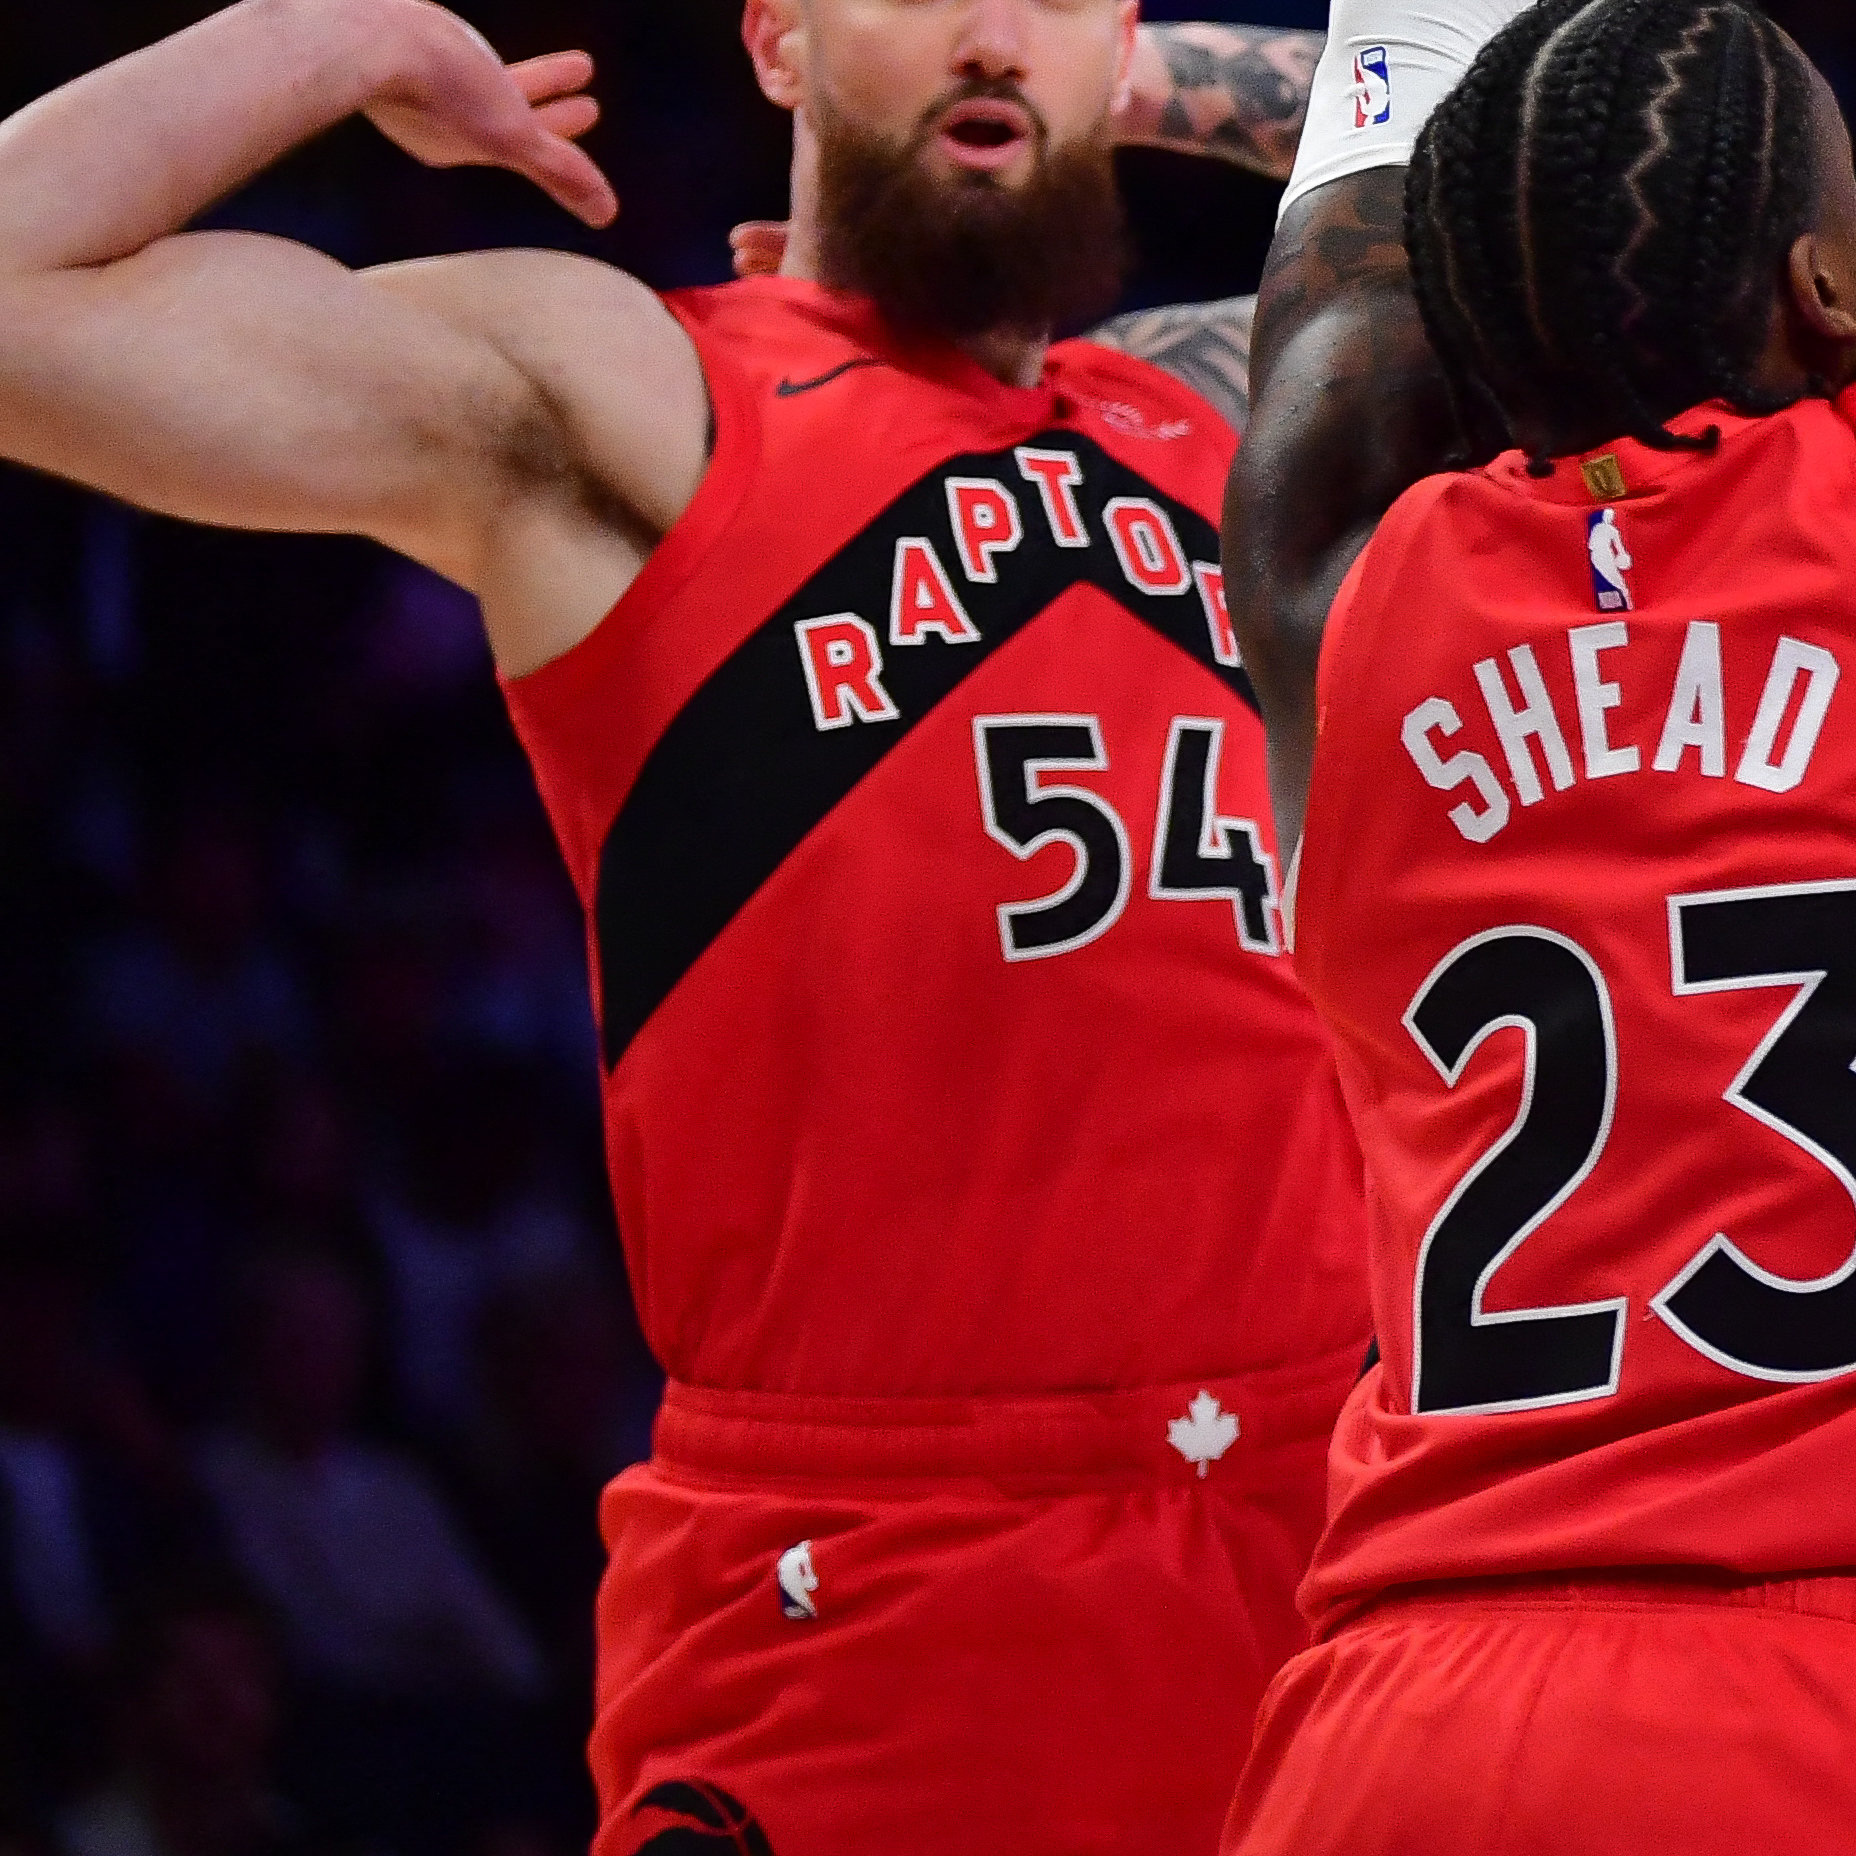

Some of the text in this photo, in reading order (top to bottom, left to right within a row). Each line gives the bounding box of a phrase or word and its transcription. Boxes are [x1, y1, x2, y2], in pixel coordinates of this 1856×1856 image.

[795, 447, 1242, 731] RAPTO
[972, 714, 1280, 963] 54
[1401, 620, 1841, 844] SHEAD
